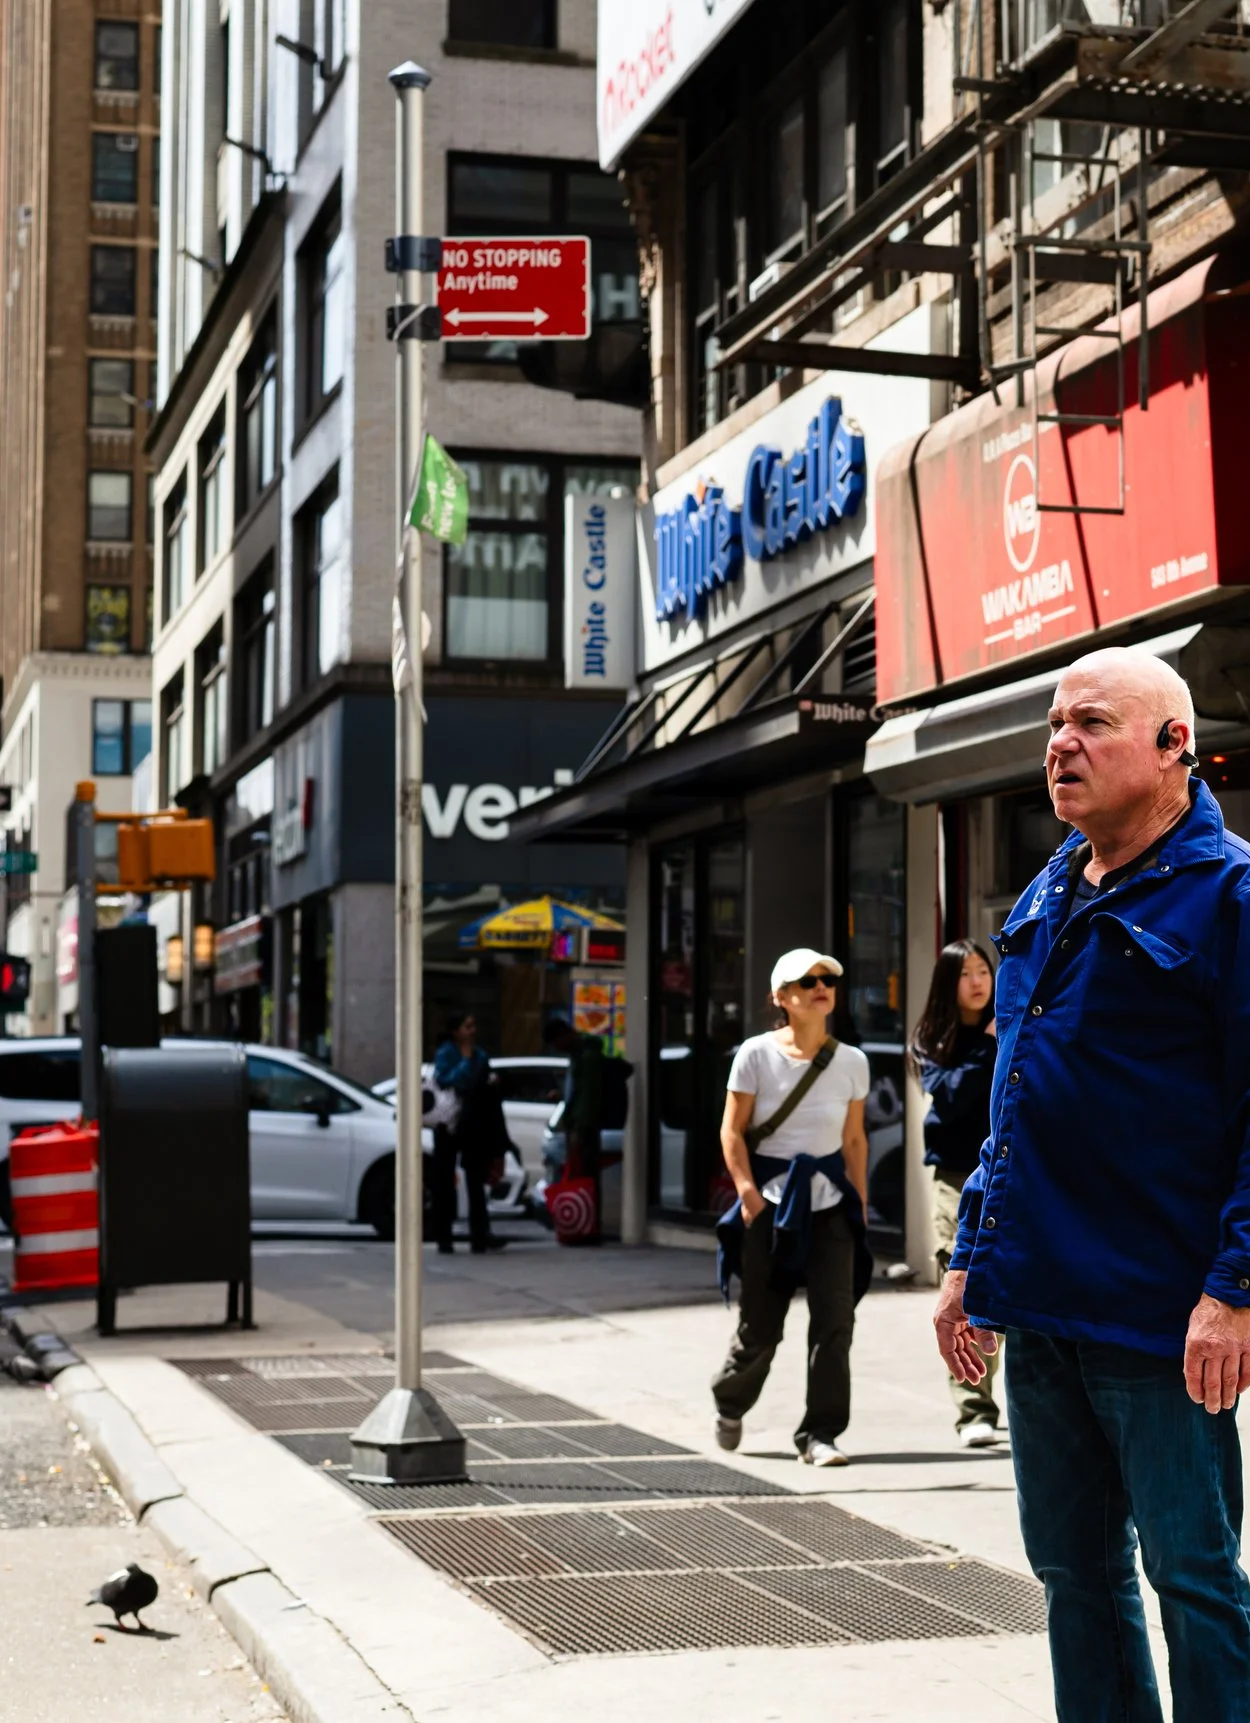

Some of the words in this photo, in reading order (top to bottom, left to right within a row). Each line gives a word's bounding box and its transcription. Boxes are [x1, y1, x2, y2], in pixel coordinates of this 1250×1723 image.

[442, 249, 469, 268] NO
[473, 248, 563, 268] STOPPING
[443, 272, 519, 295] Anytime
[655, 474, 743, 623] White
[740, 394, 866, 561] Castle
[583, 504, 607, 590] Castle
[981, 560, 1075, 625] WAKAMBA
[582, 602, 609, 677] White
[1013, 612, 1042, 641] BAR
[813, 702, 867, 723] White
[421, 769, 574, 841] ver
